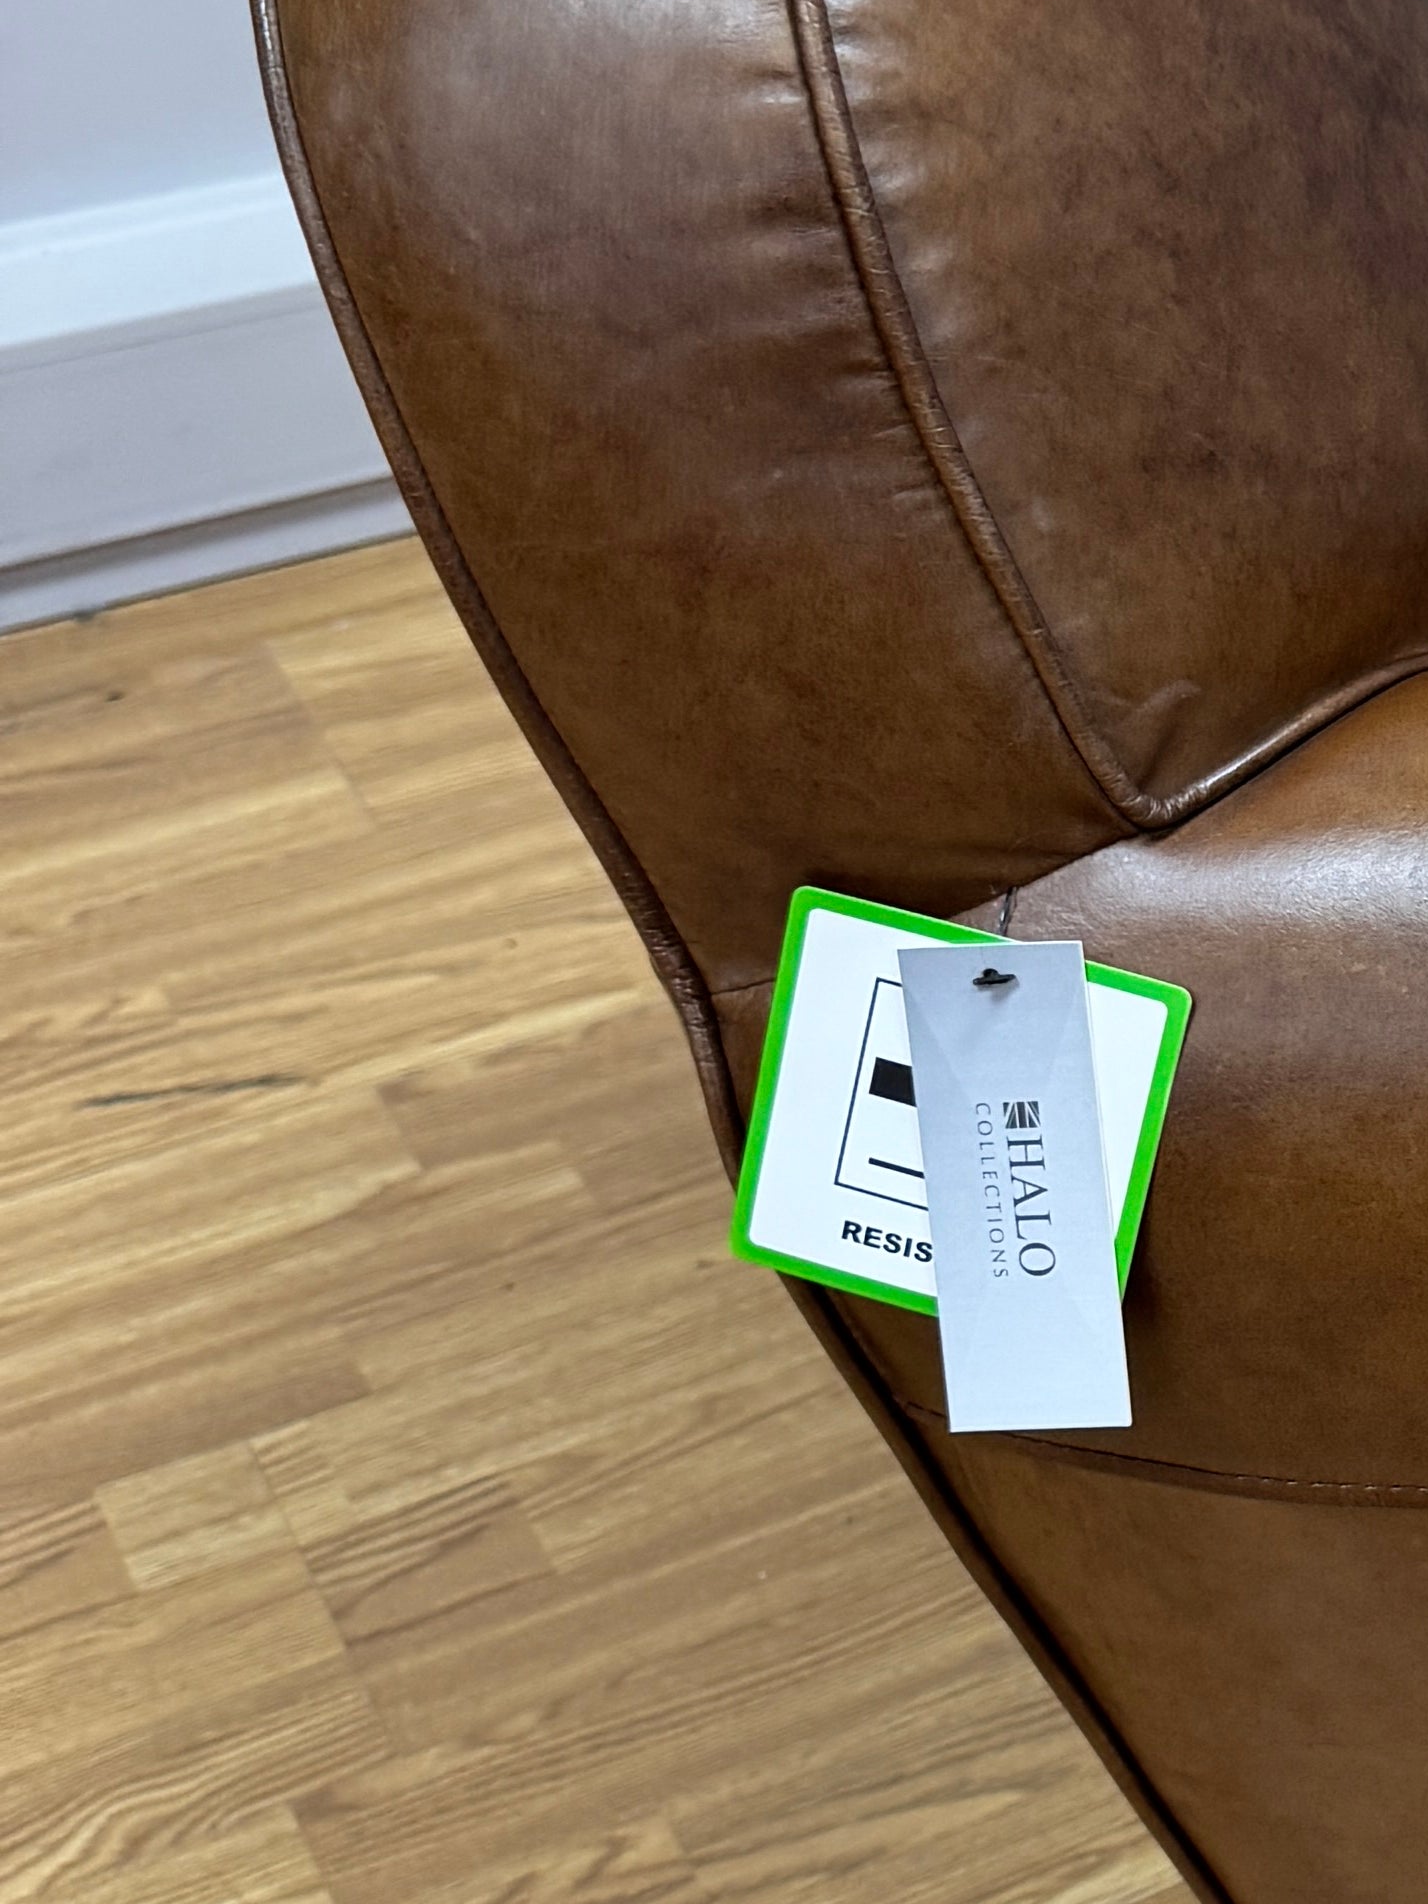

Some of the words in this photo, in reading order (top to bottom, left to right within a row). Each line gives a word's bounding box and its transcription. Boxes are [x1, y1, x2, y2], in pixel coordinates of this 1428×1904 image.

[841, 1220, 933, 1263] RESIS
[974, 1102, 1009, 1278] COLLECTIONS
[1007, 1135, 1056, 1277] HALO
